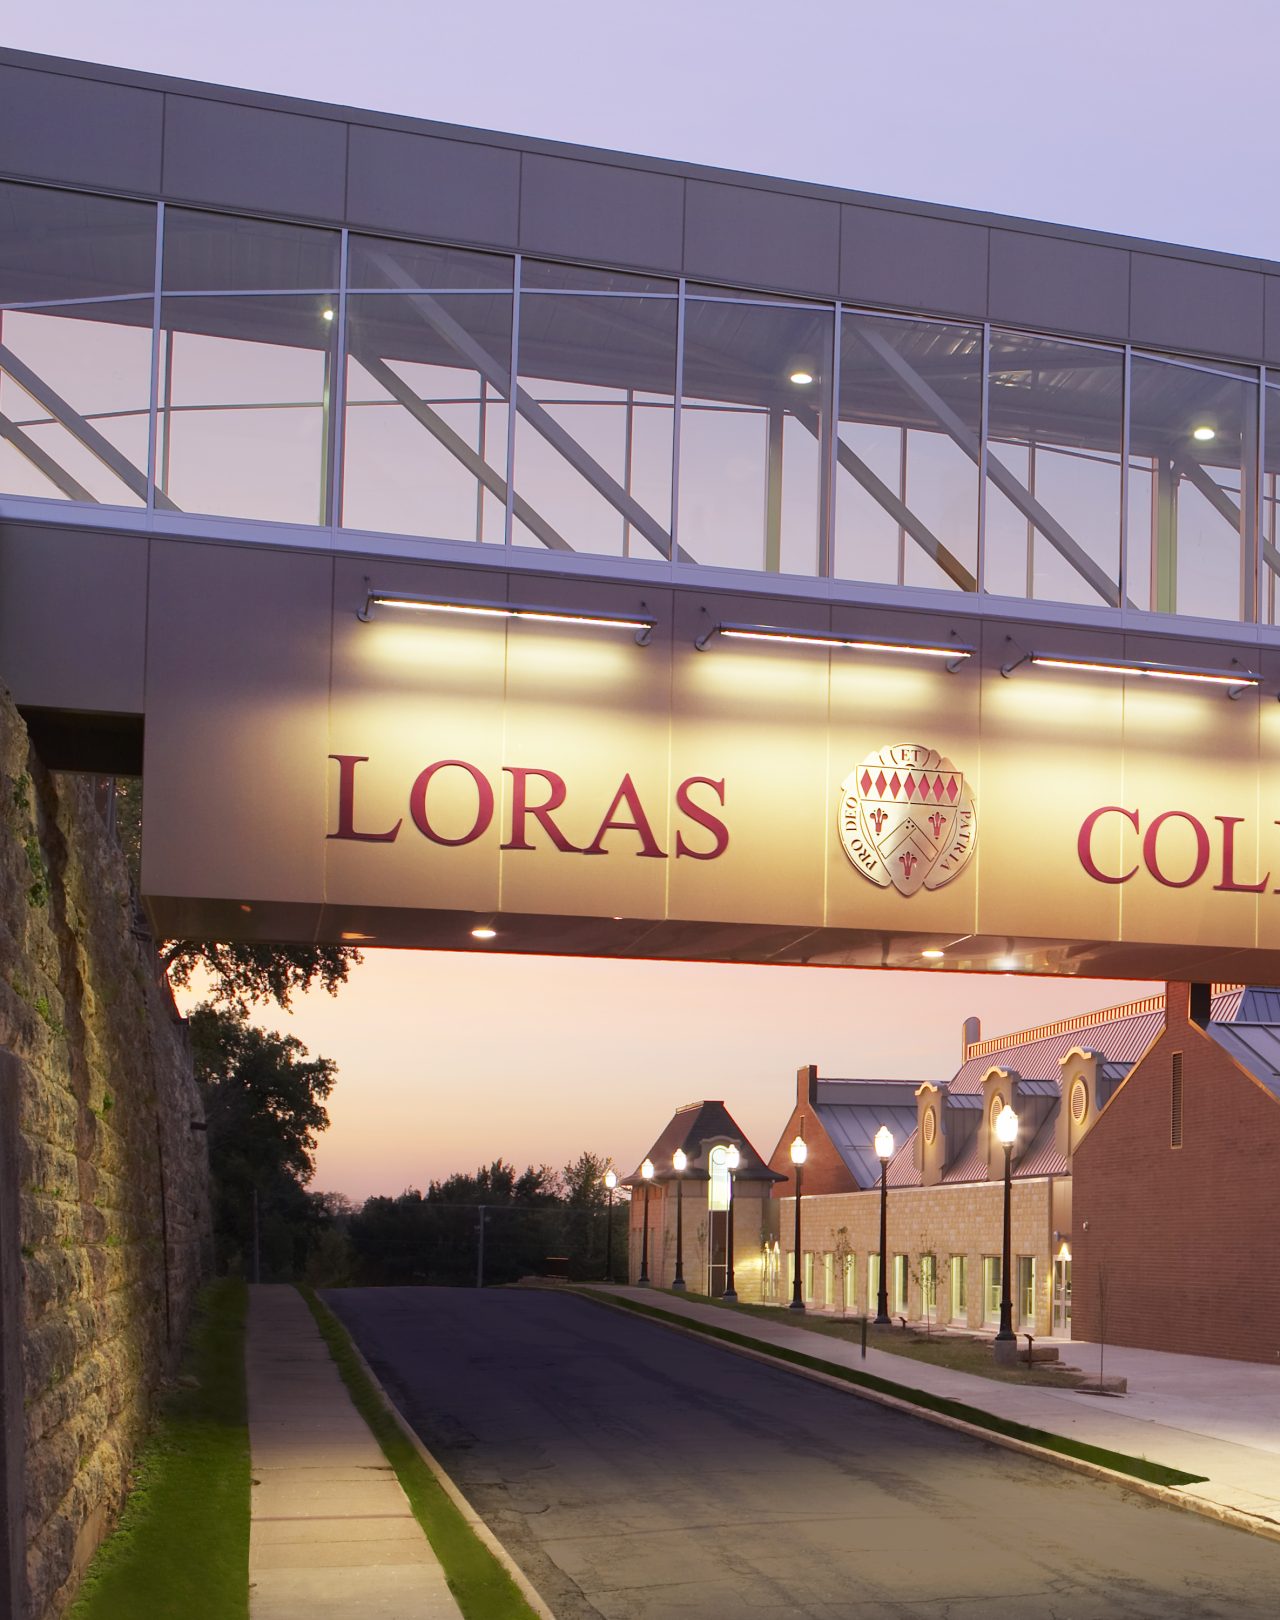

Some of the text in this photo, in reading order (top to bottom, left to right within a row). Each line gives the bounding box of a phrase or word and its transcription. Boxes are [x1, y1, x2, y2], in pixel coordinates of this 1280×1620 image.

[326, 754, 730, 861] LORAS
[845, 749, 972, 872] PRO DEO ET PATRIA
